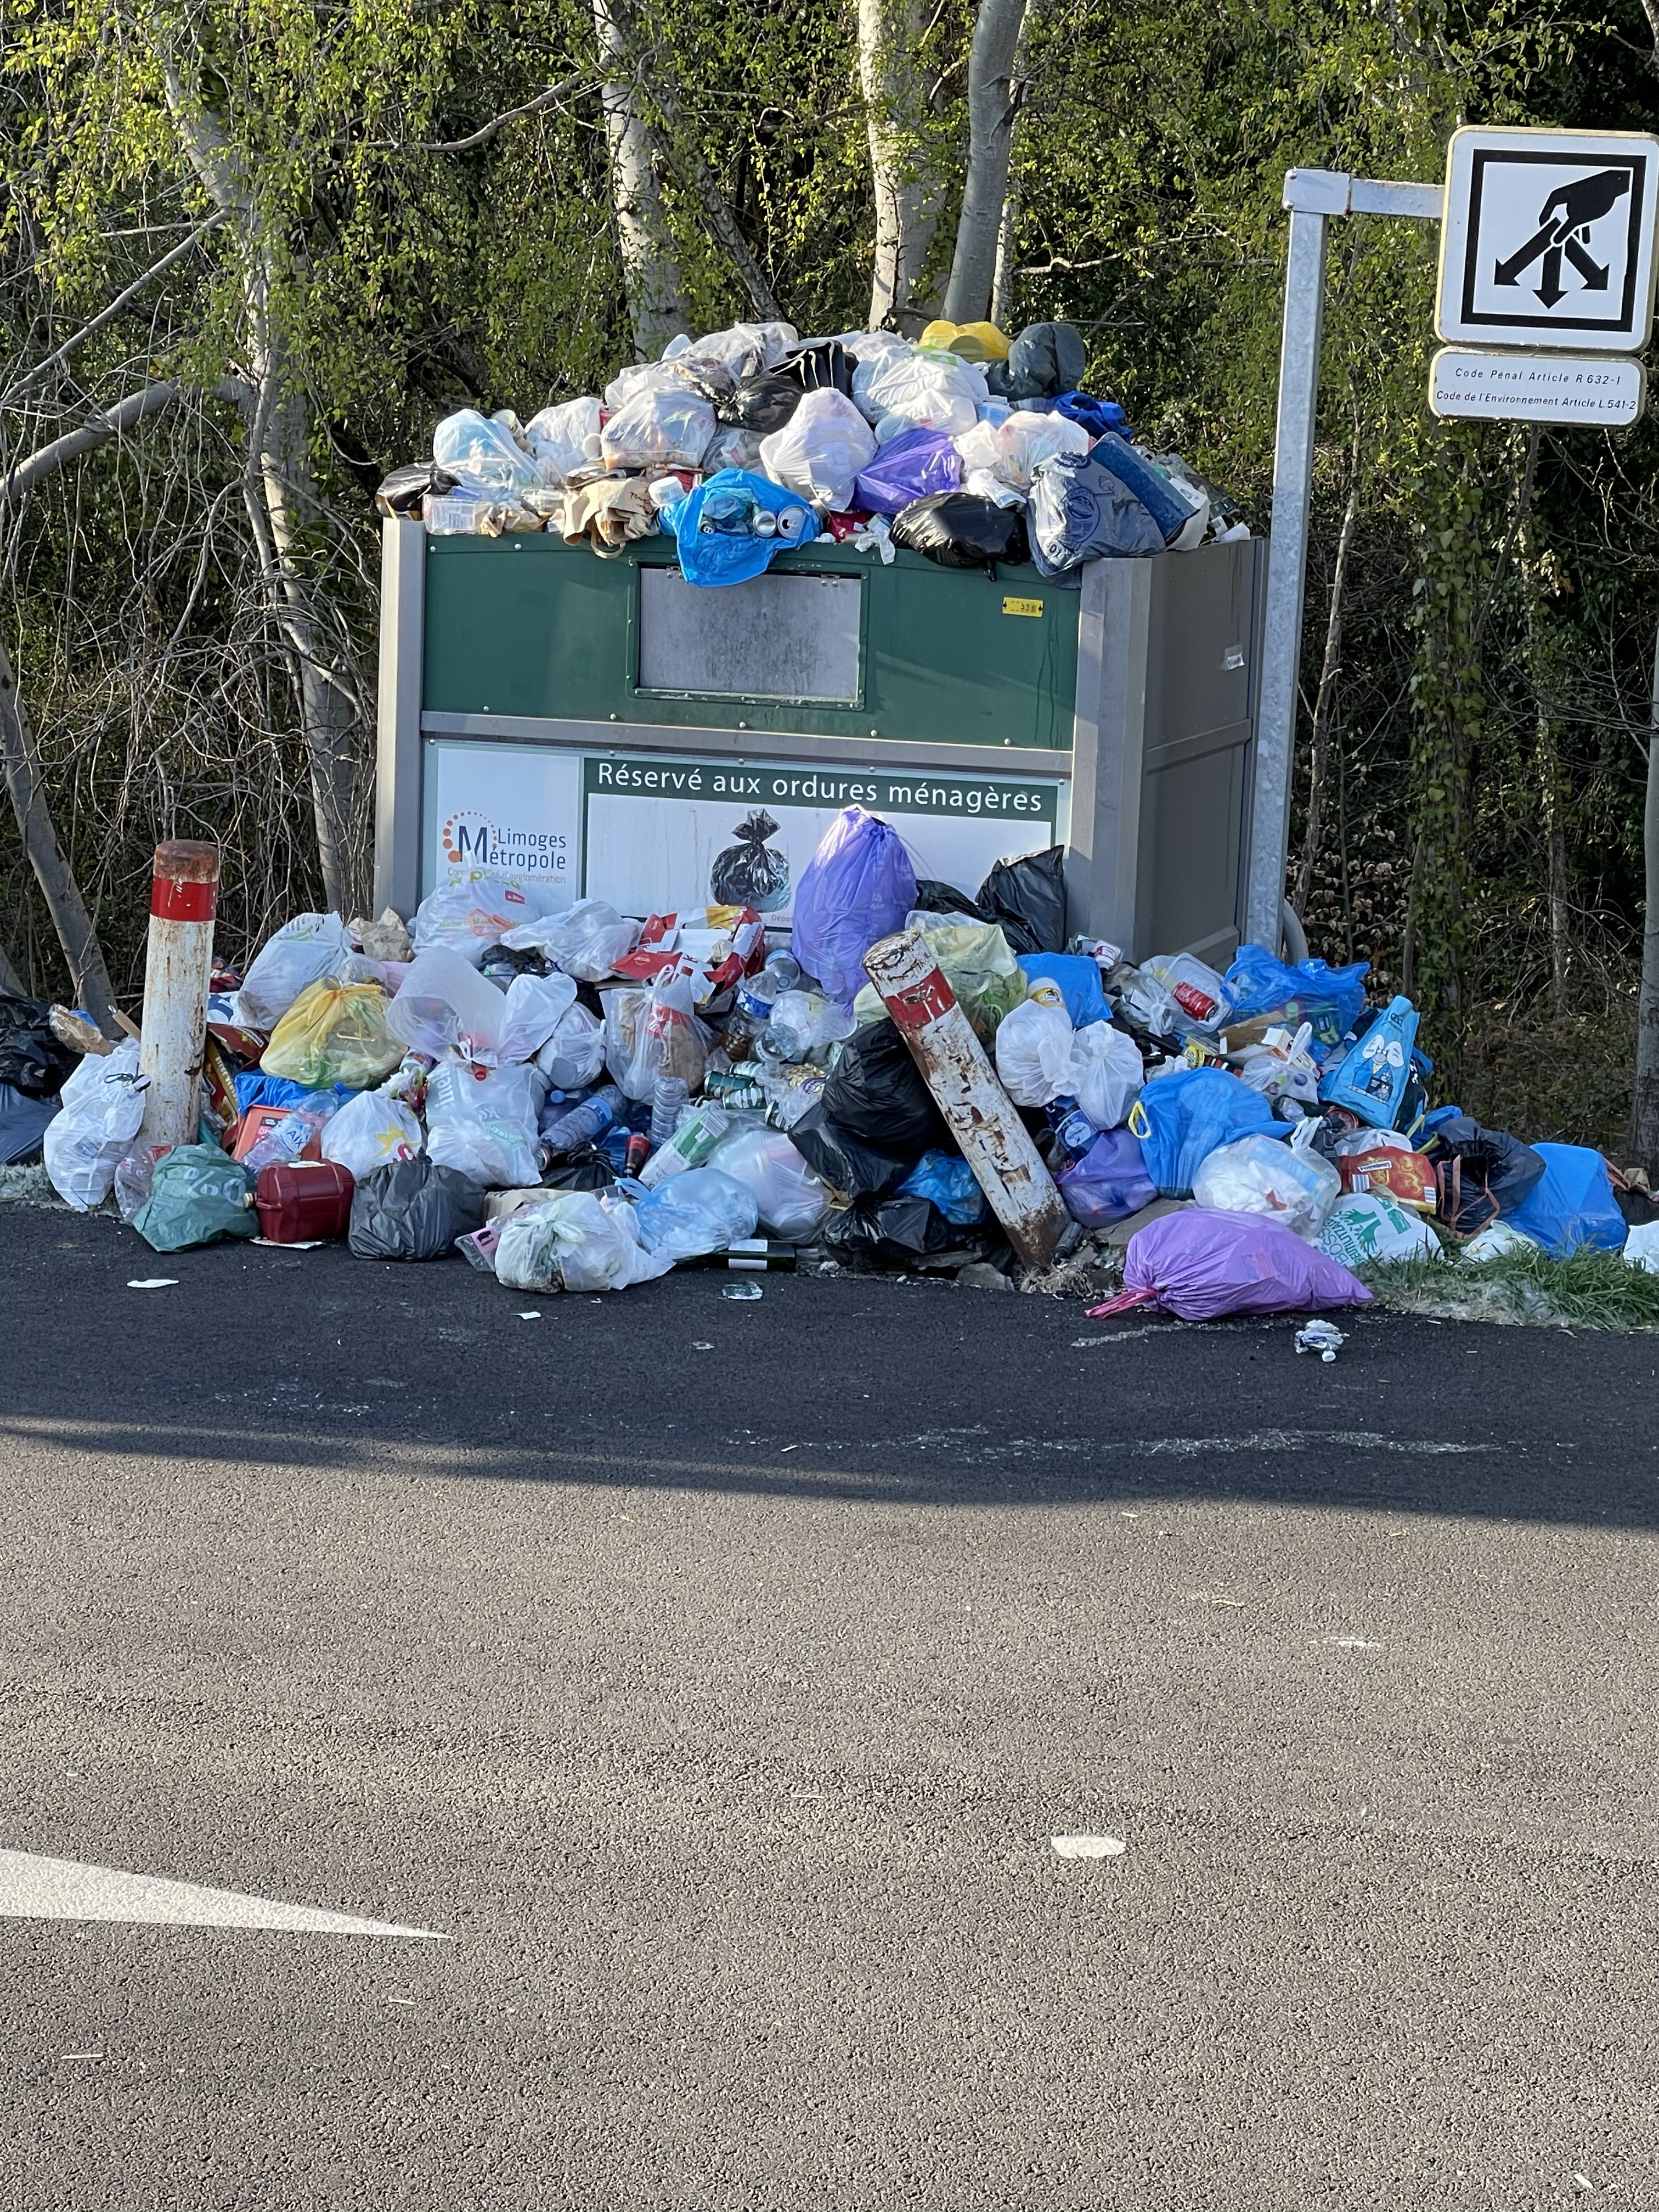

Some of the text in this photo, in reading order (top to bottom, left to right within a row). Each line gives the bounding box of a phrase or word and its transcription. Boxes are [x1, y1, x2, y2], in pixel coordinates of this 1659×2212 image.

[1455, 368, 1621, 385] Code Pénal Article R 632-1
[1436, 391, 1461, 400] Code
[1464, 392, 1476, 401] de
[1561, 397, 1596, 408] Article
[598, 763, 1042, 814] Réservé aux ordures ménagères
[498, 827, 566, 851] Limoges
